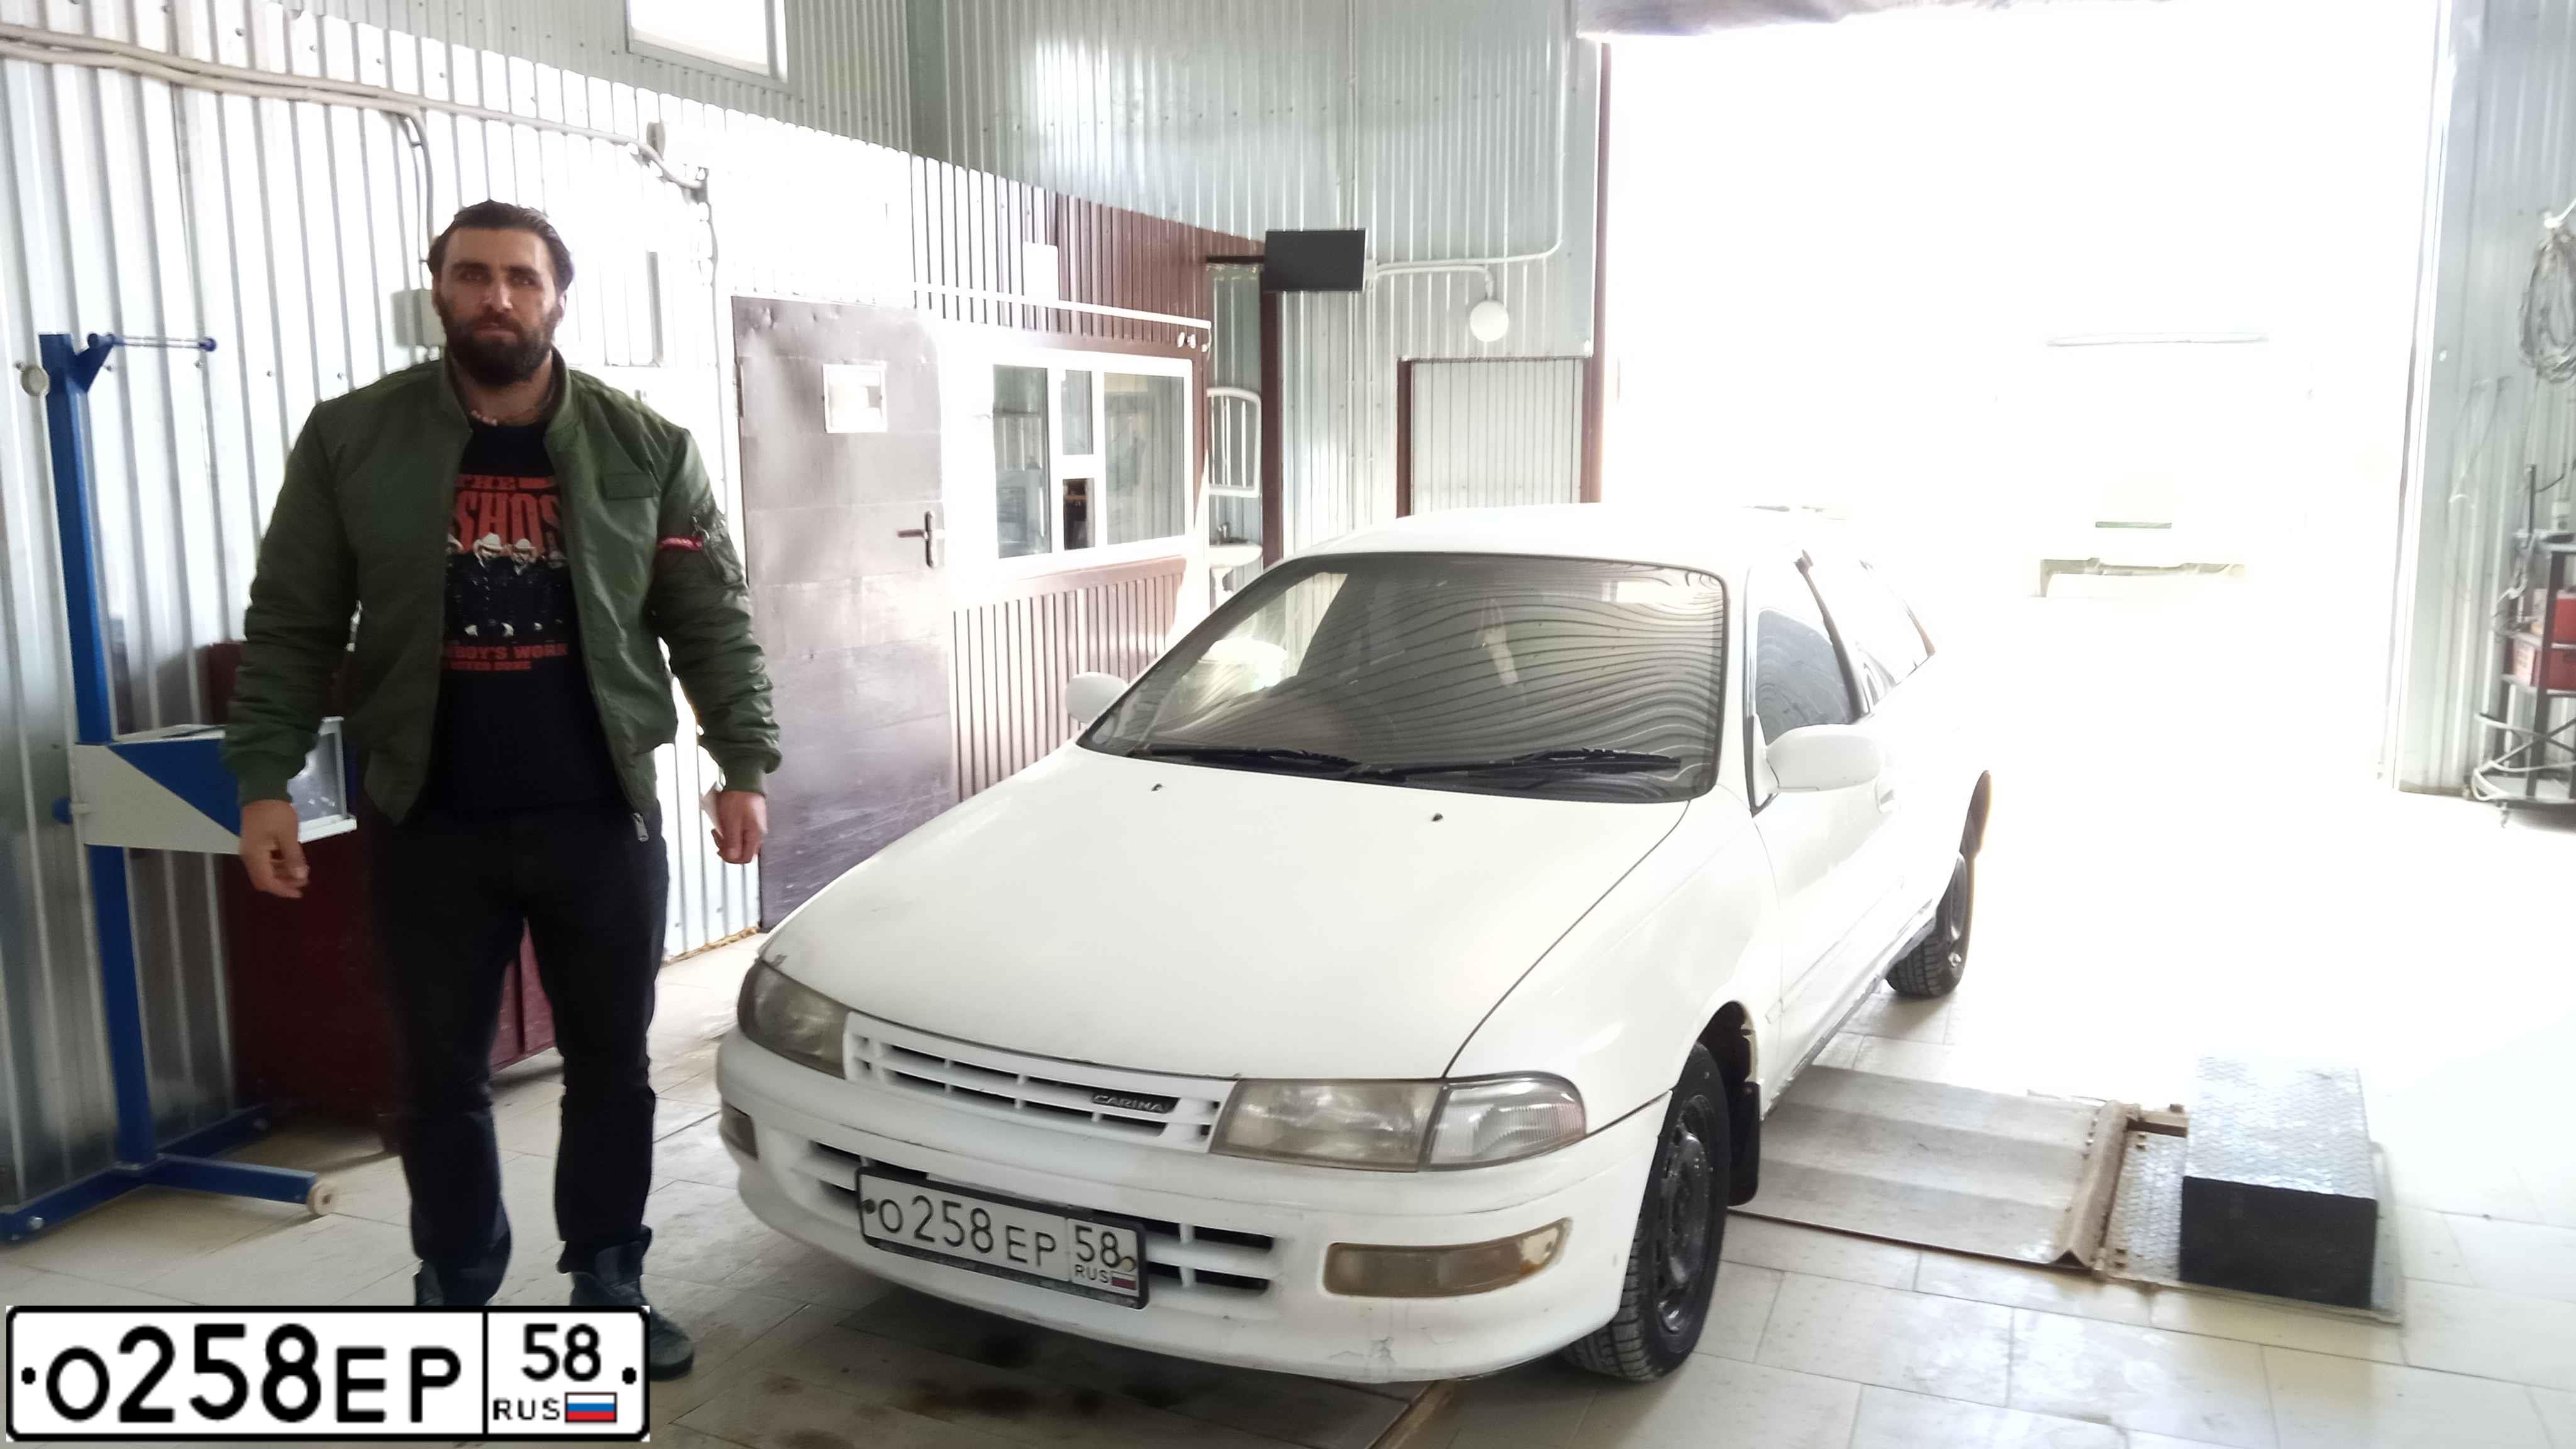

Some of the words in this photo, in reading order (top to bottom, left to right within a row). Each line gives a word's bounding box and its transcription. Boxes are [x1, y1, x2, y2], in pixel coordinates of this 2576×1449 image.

[1094, 1094, 1163, 1111] CARINA
[1075, 1224, 1120, 1268] 58
[1075, 1264, 1109, 1283] RUS
